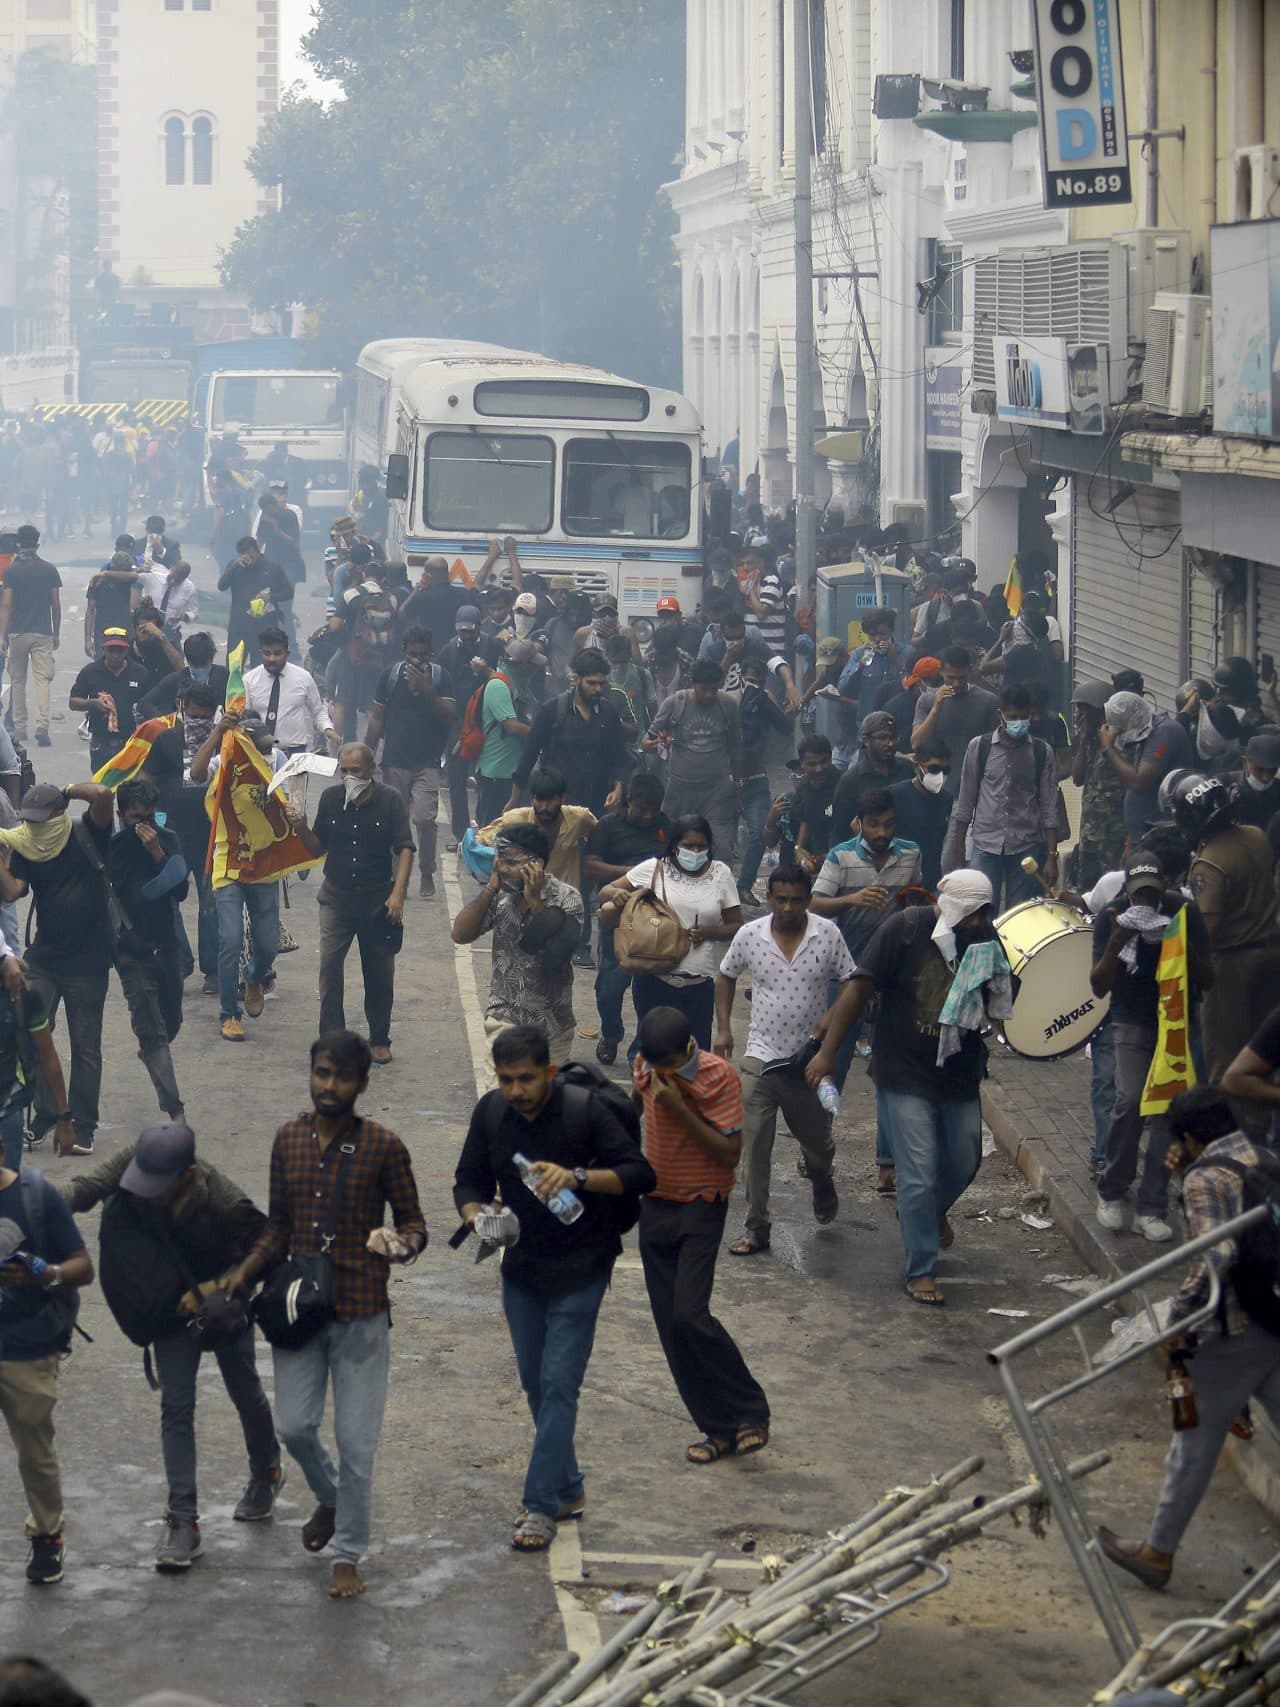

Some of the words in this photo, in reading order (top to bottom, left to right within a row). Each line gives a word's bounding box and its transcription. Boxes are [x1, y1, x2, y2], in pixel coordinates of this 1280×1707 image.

[1056, 175, 1122, 196] No.89
[1129, 864, 1158, 875] adidas
[1043, 999, 1096, 1039] SPARKLE
